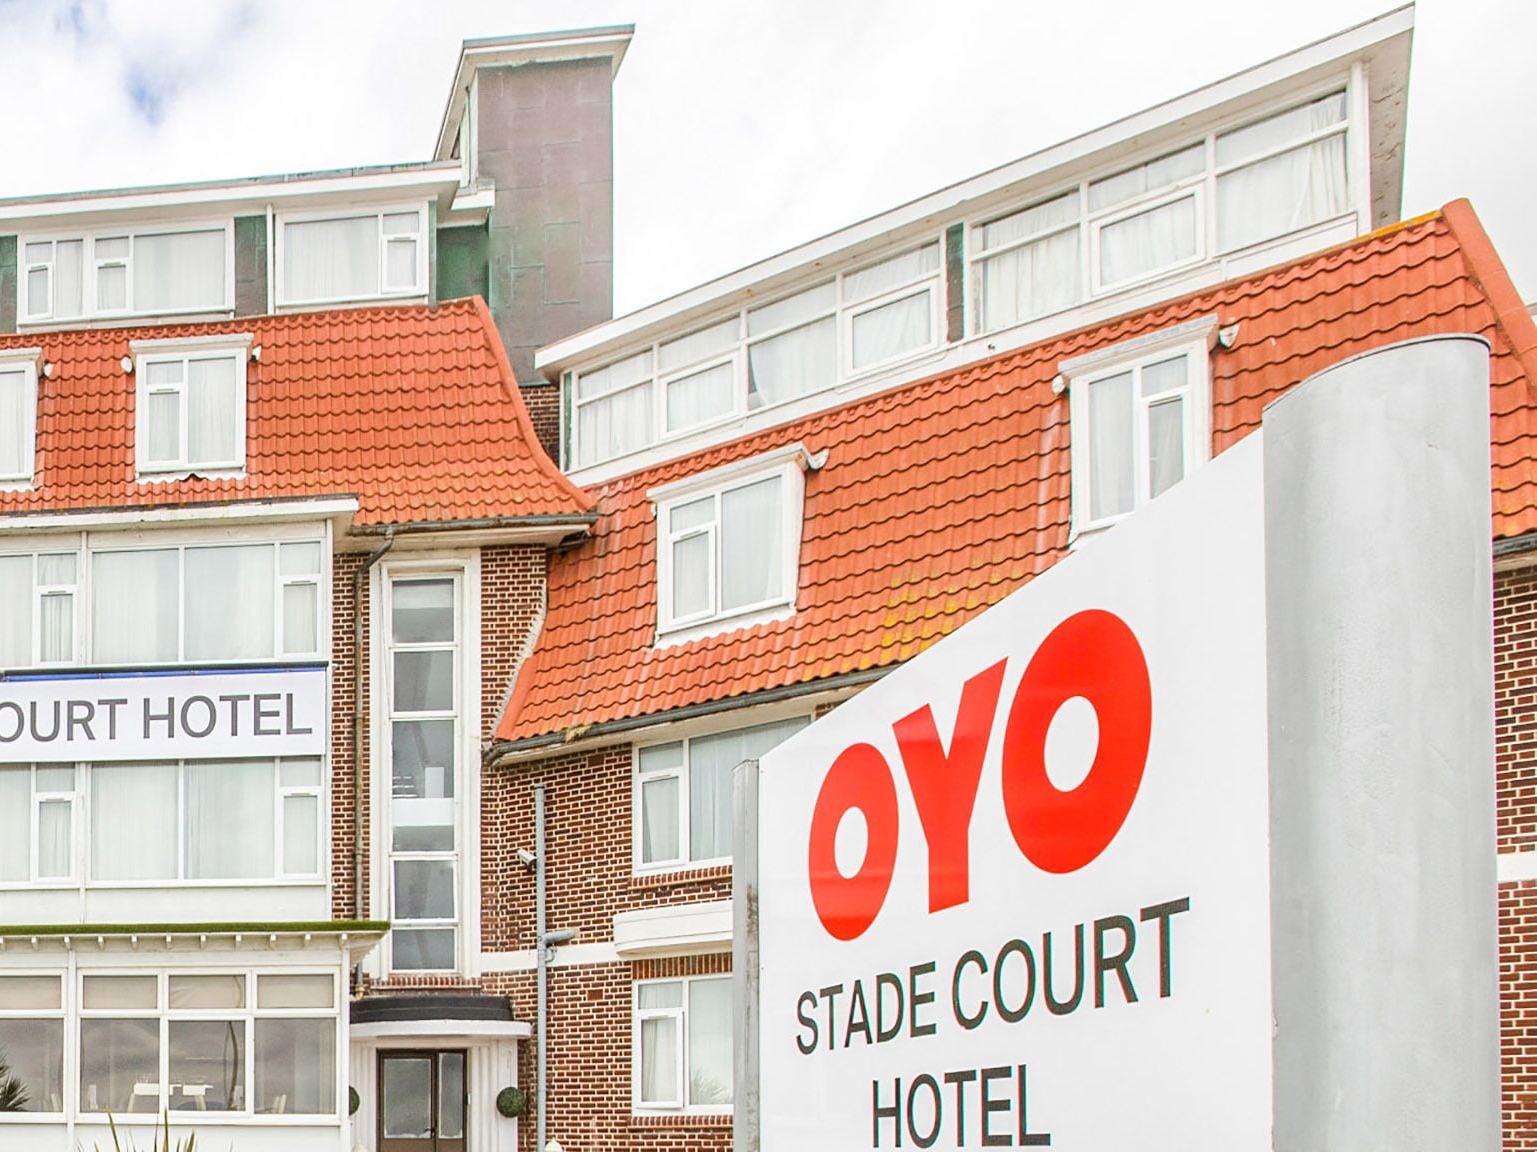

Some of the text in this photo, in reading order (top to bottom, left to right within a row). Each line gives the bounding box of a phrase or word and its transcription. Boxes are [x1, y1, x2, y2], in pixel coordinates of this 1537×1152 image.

[144, 693, 312, 738] HOTEL
[808, 608, 1153, 942] OYO
[797, 897, 1189, 1055] STADE COURT
[873, 1064, 1050, 1148] HOTEL
